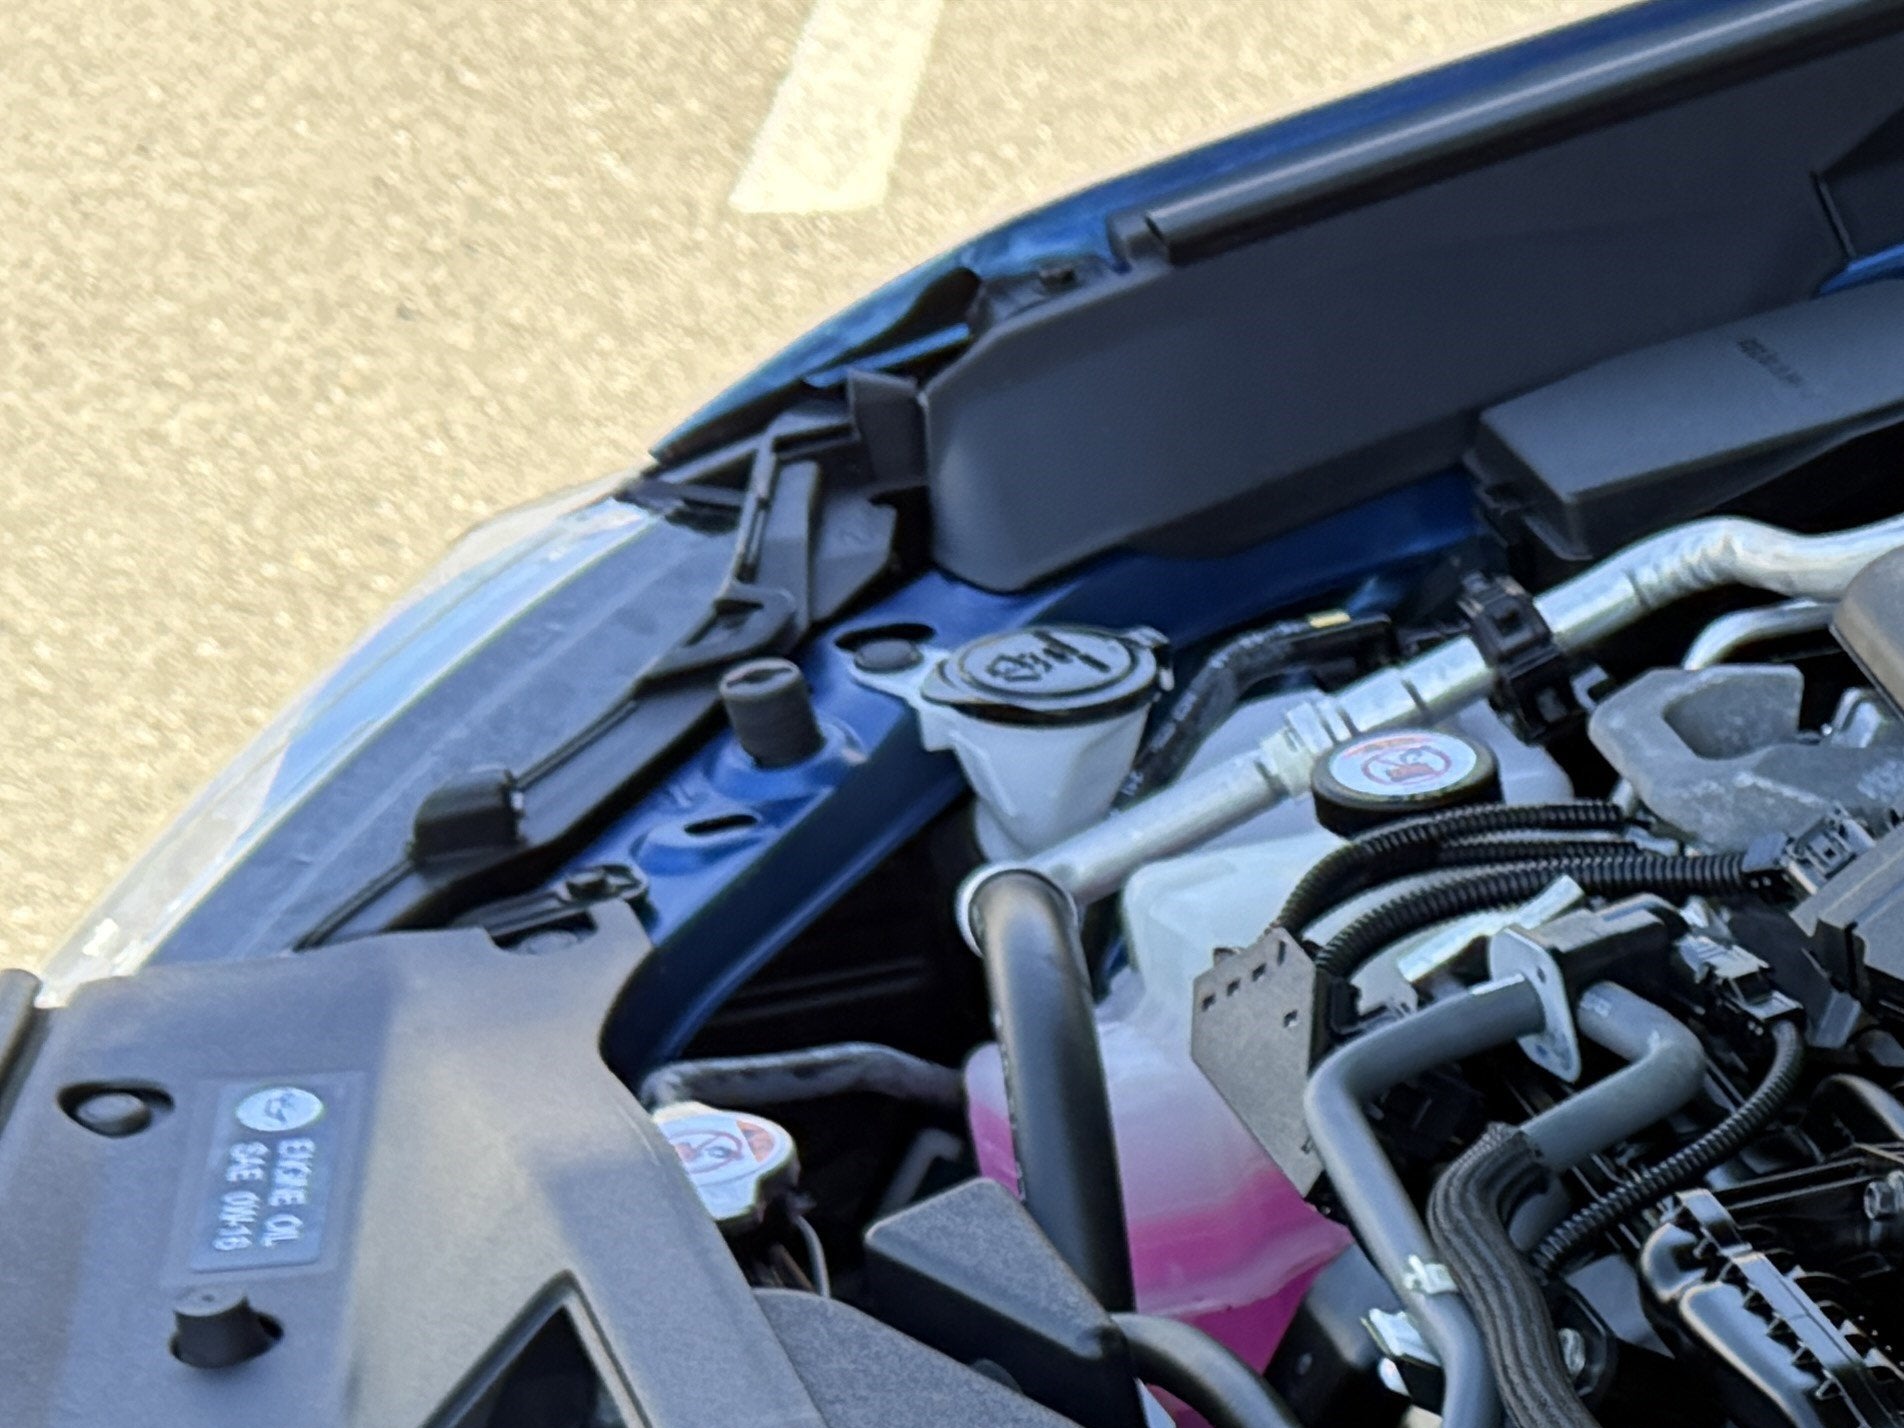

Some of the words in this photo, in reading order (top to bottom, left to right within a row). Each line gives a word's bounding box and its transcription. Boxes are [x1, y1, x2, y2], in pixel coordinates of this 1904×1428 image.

[225, 1143, 269, 1180] SAE
[267, 1139, 315, 1205] ENGINE
[260, 1217, 303, 1246] OIL
